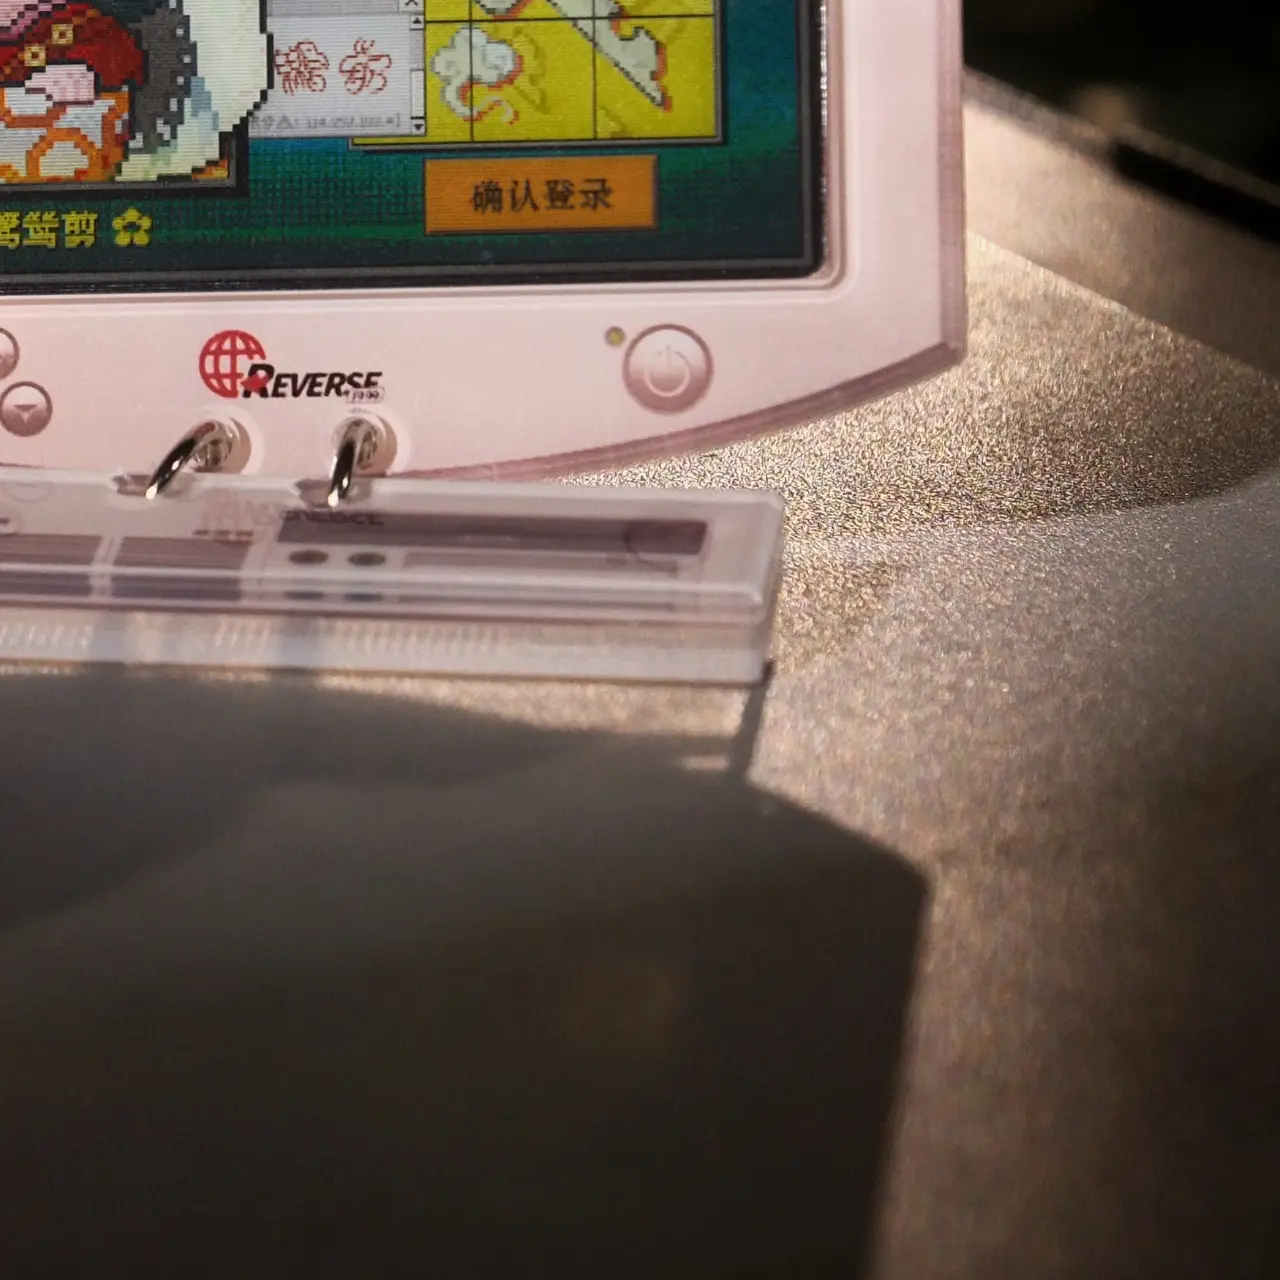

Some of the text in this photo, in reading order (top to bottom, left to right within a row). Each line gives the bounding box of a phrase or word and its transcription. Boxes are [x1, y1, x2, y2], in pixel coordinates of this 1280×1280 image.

[472, 178, 612, 214] 确认登录
[242, 363, 383, 398] REVERSE
